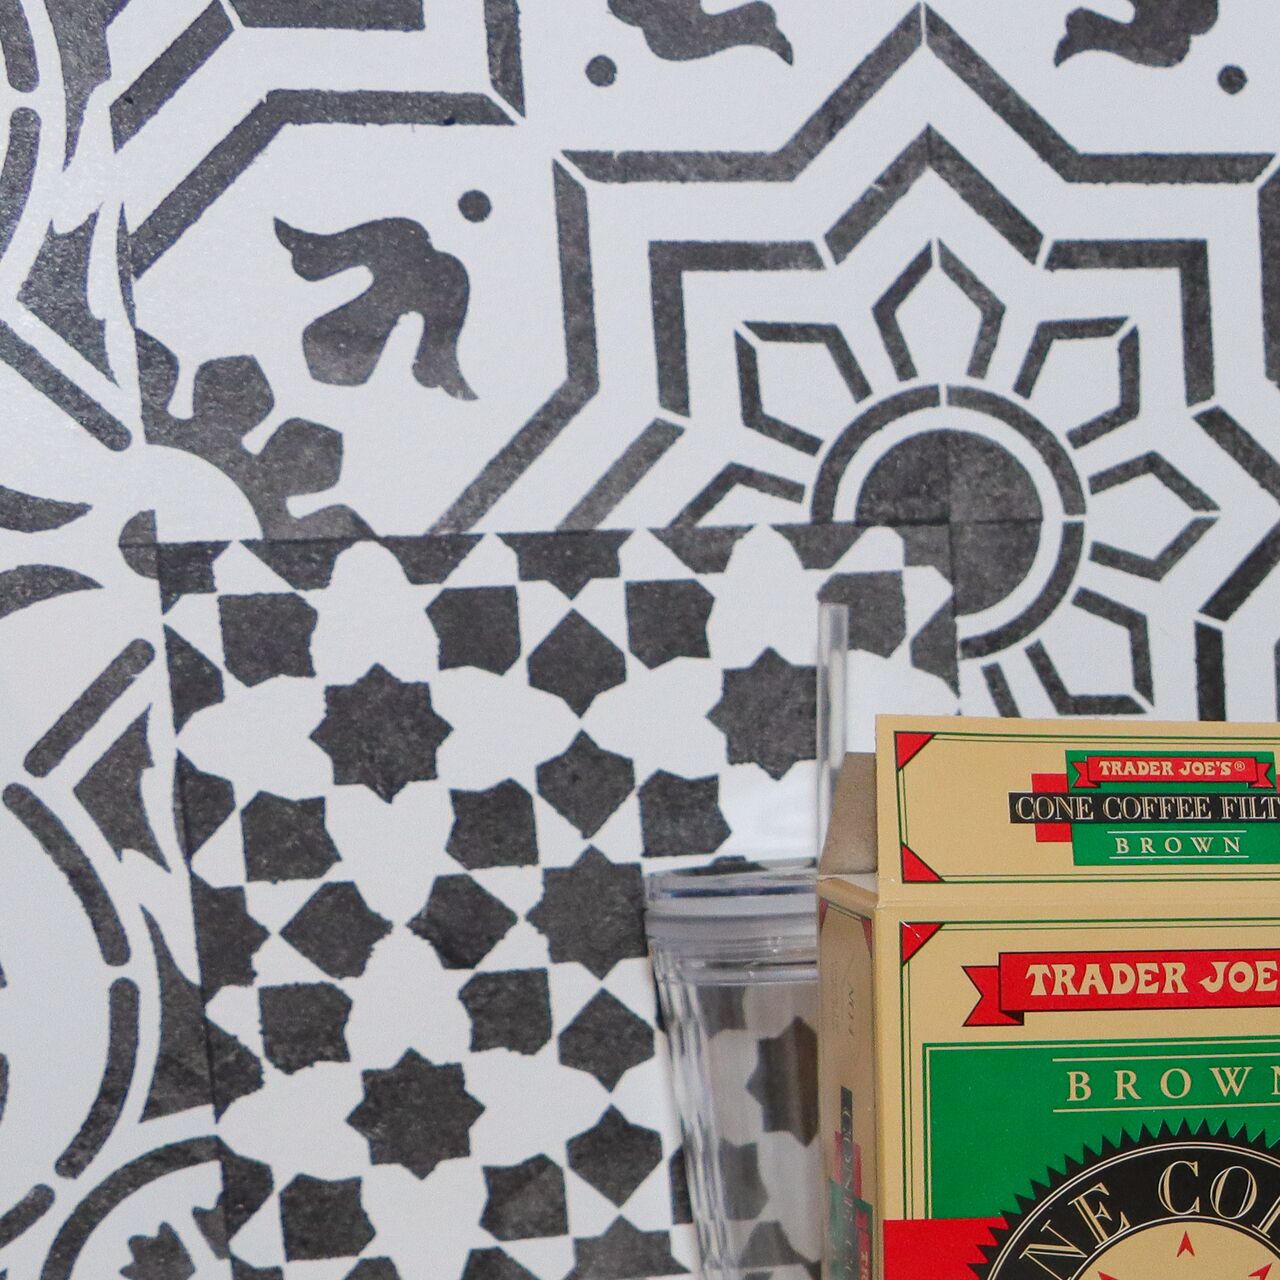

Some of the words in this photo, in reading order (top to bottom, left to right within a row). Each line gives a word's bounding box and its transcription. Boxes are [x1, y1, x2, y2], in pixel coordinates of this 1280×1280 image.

[1100, 760, 1173, 777] TRADER
[1015, 795, 1095, 820] CONE
[1102, 795, 1212, 820] COFFEE
[1115, 836, 1241, 855] BROWN
[1025, 961, 1189, 996] TRADER
